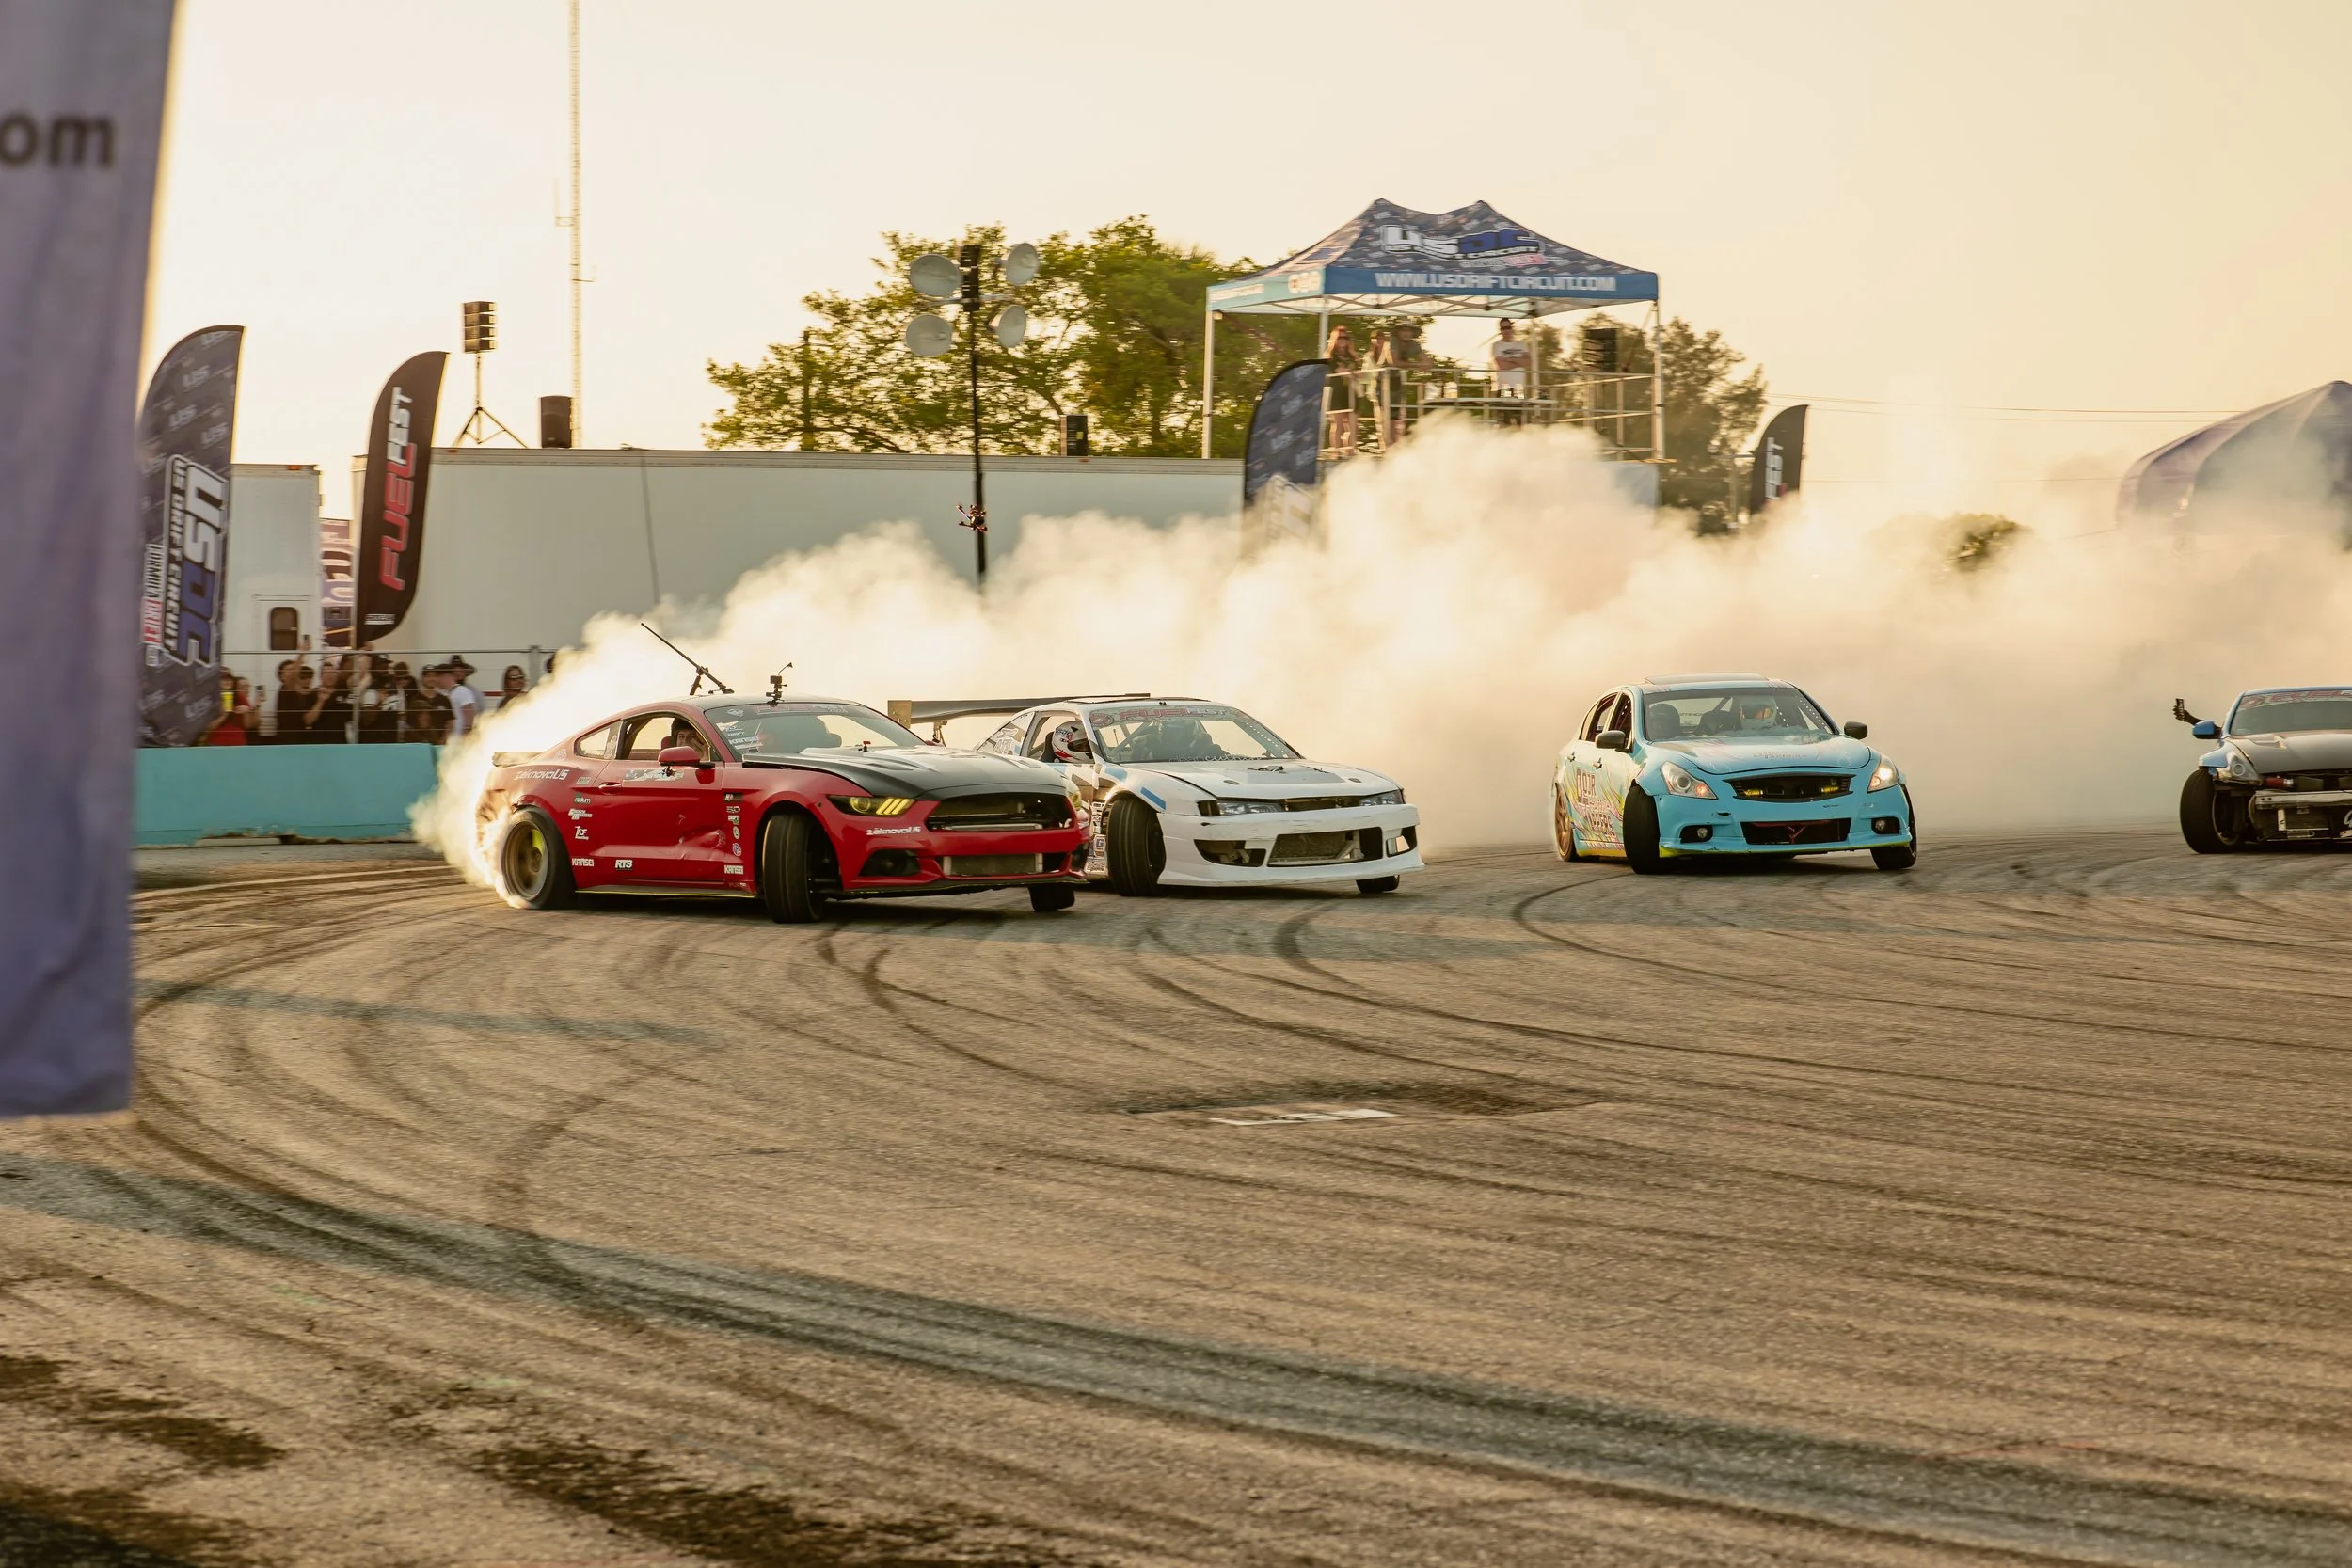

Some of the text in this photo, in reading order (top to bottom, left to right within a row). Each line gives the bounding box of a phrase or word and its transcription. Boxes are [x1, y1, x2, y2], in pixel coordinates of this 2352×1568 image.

[1387, 226, 1540, 254] USDC
[380, 387, 417, 590] FUELFEST
[168, 494, 185, 562] DRIFT
[145, 546, 163, 597] FORMULA
[178, 465, 224, 662] USDC
[143, 598, 162, 642] DRIFT
[165, 563, 182, 651] CIRCUIT
[572, 858, 594, 866] KANSEI
[615, 859, 633, 868] RTS
